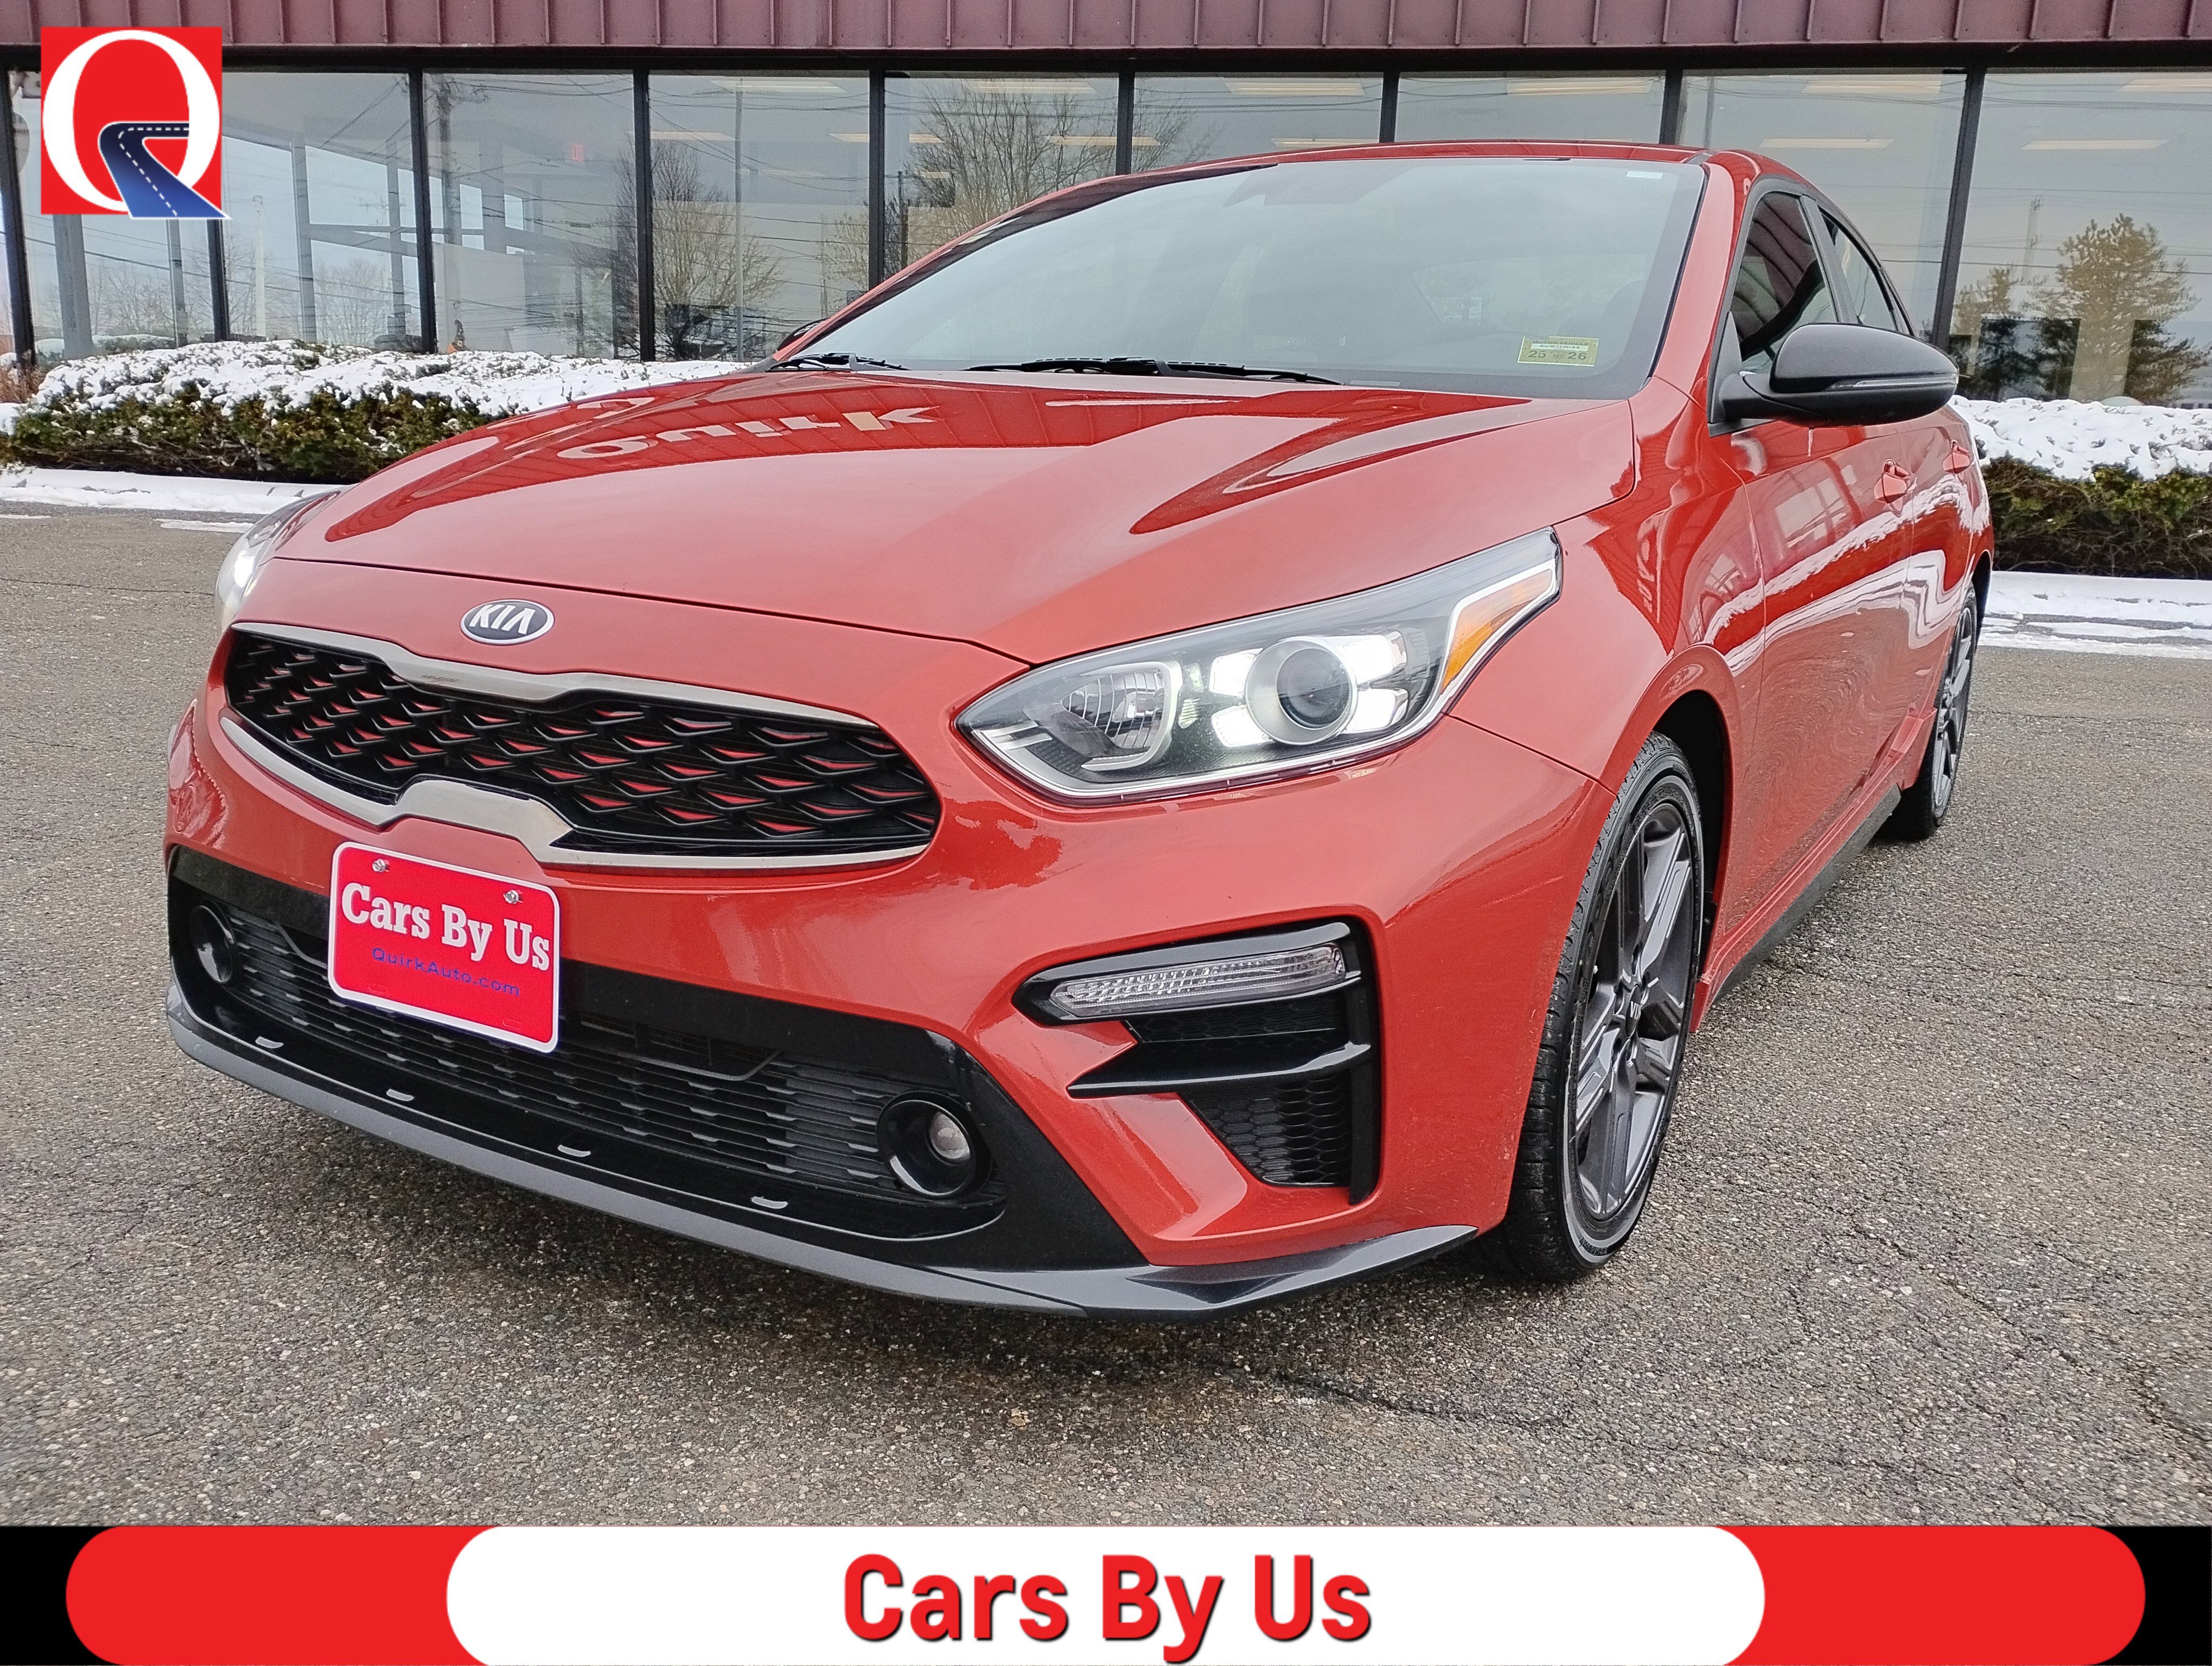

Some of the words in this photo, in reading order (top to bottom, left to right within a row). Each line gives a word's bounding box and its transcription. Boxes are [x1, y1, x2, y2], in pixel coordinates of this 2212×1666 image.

[1528, 350, 1547, 358] 25
[1567, 351, 1587, 360] 26
[468, 604, 536, 635] KIA
[342, 882, 430, 940] Cars
[441, 904, 493, 962] By
[503, 918, 550, 971] Us
[371, 947, 521, 997] QuirkAuto.com
